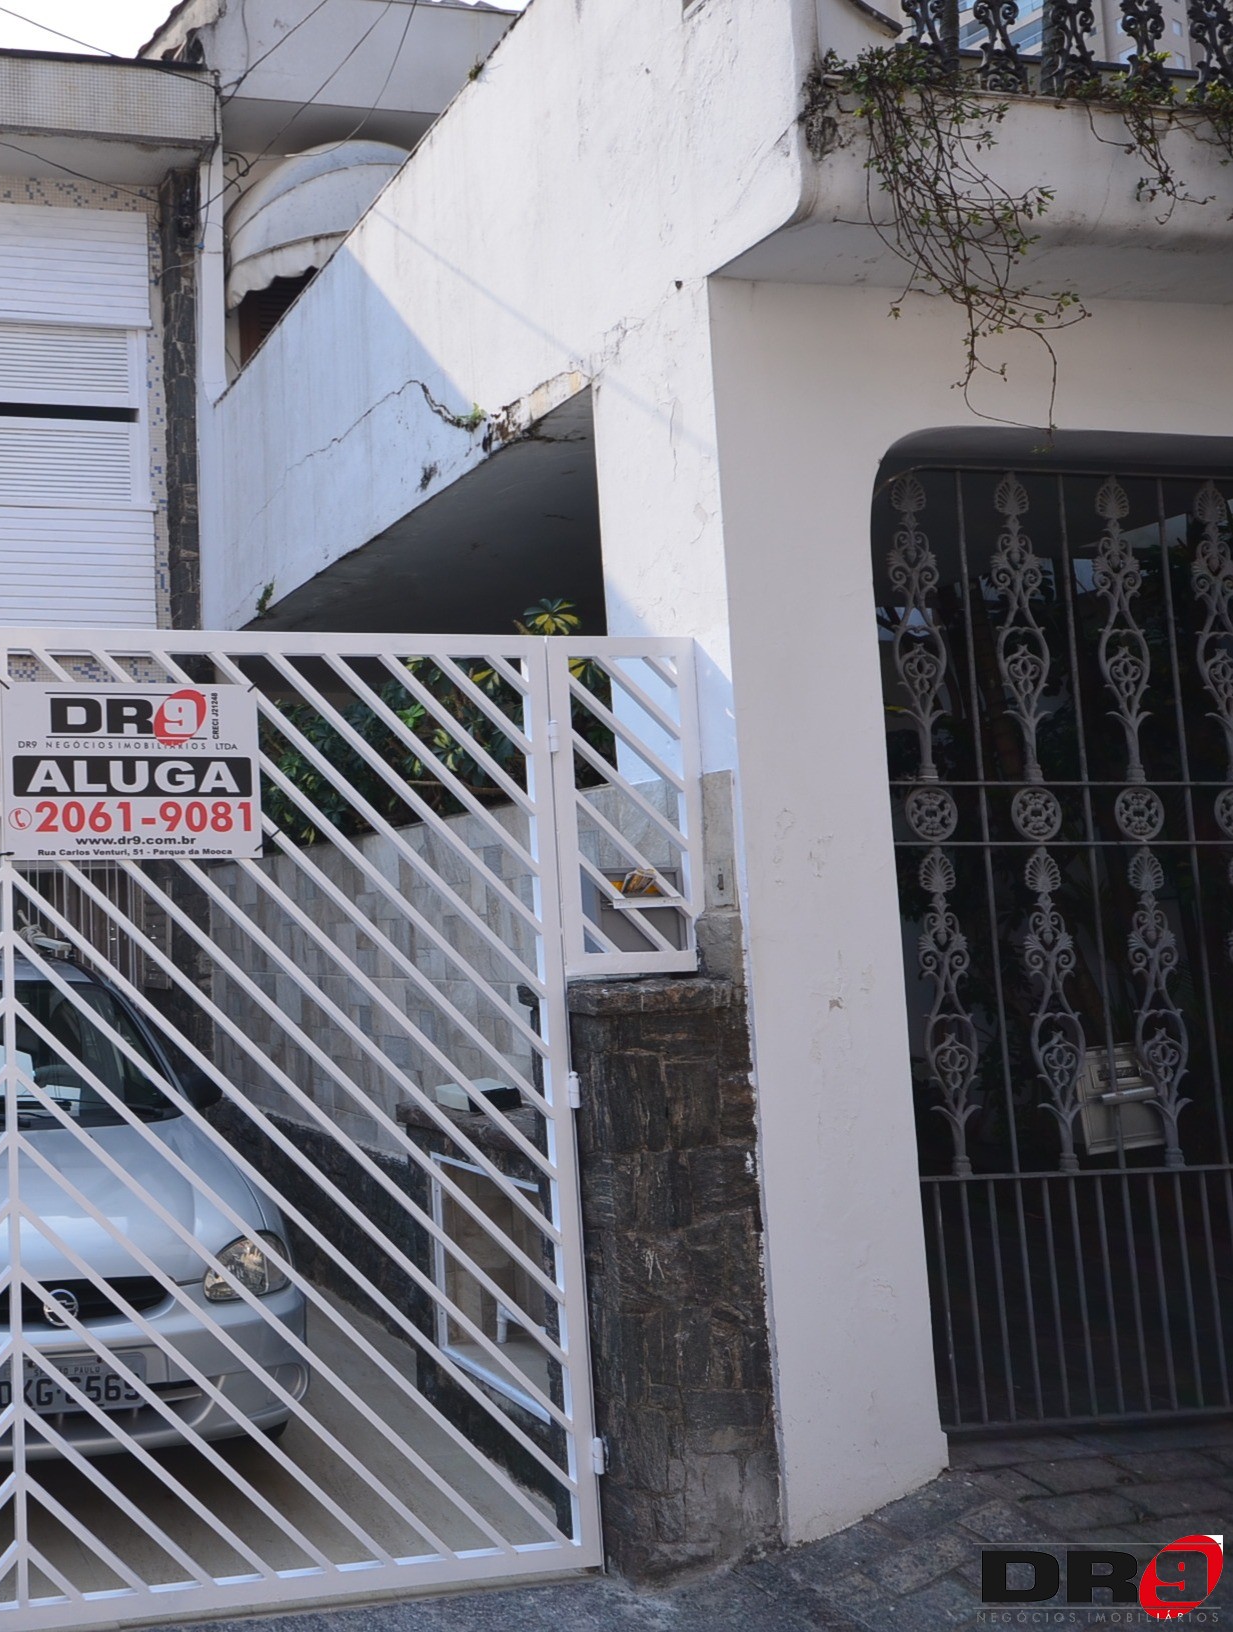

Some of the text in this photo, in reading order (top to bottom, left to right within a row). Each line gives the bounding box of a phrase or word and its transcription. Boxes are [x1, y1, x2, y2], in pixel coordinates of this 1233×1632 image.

[50, 697, 198, 734] DR9
[211, 692, 220, 740] CRECI J21248
[18, 741, 37, 749] DR9
[45, 740, 113, 750] NEGÓCIOS
[26, 760, 240, 793] ALUGA
[35, 801, 252, 833] 2061-9081
[75, 836, 196, 845] www.dr9.com.br
